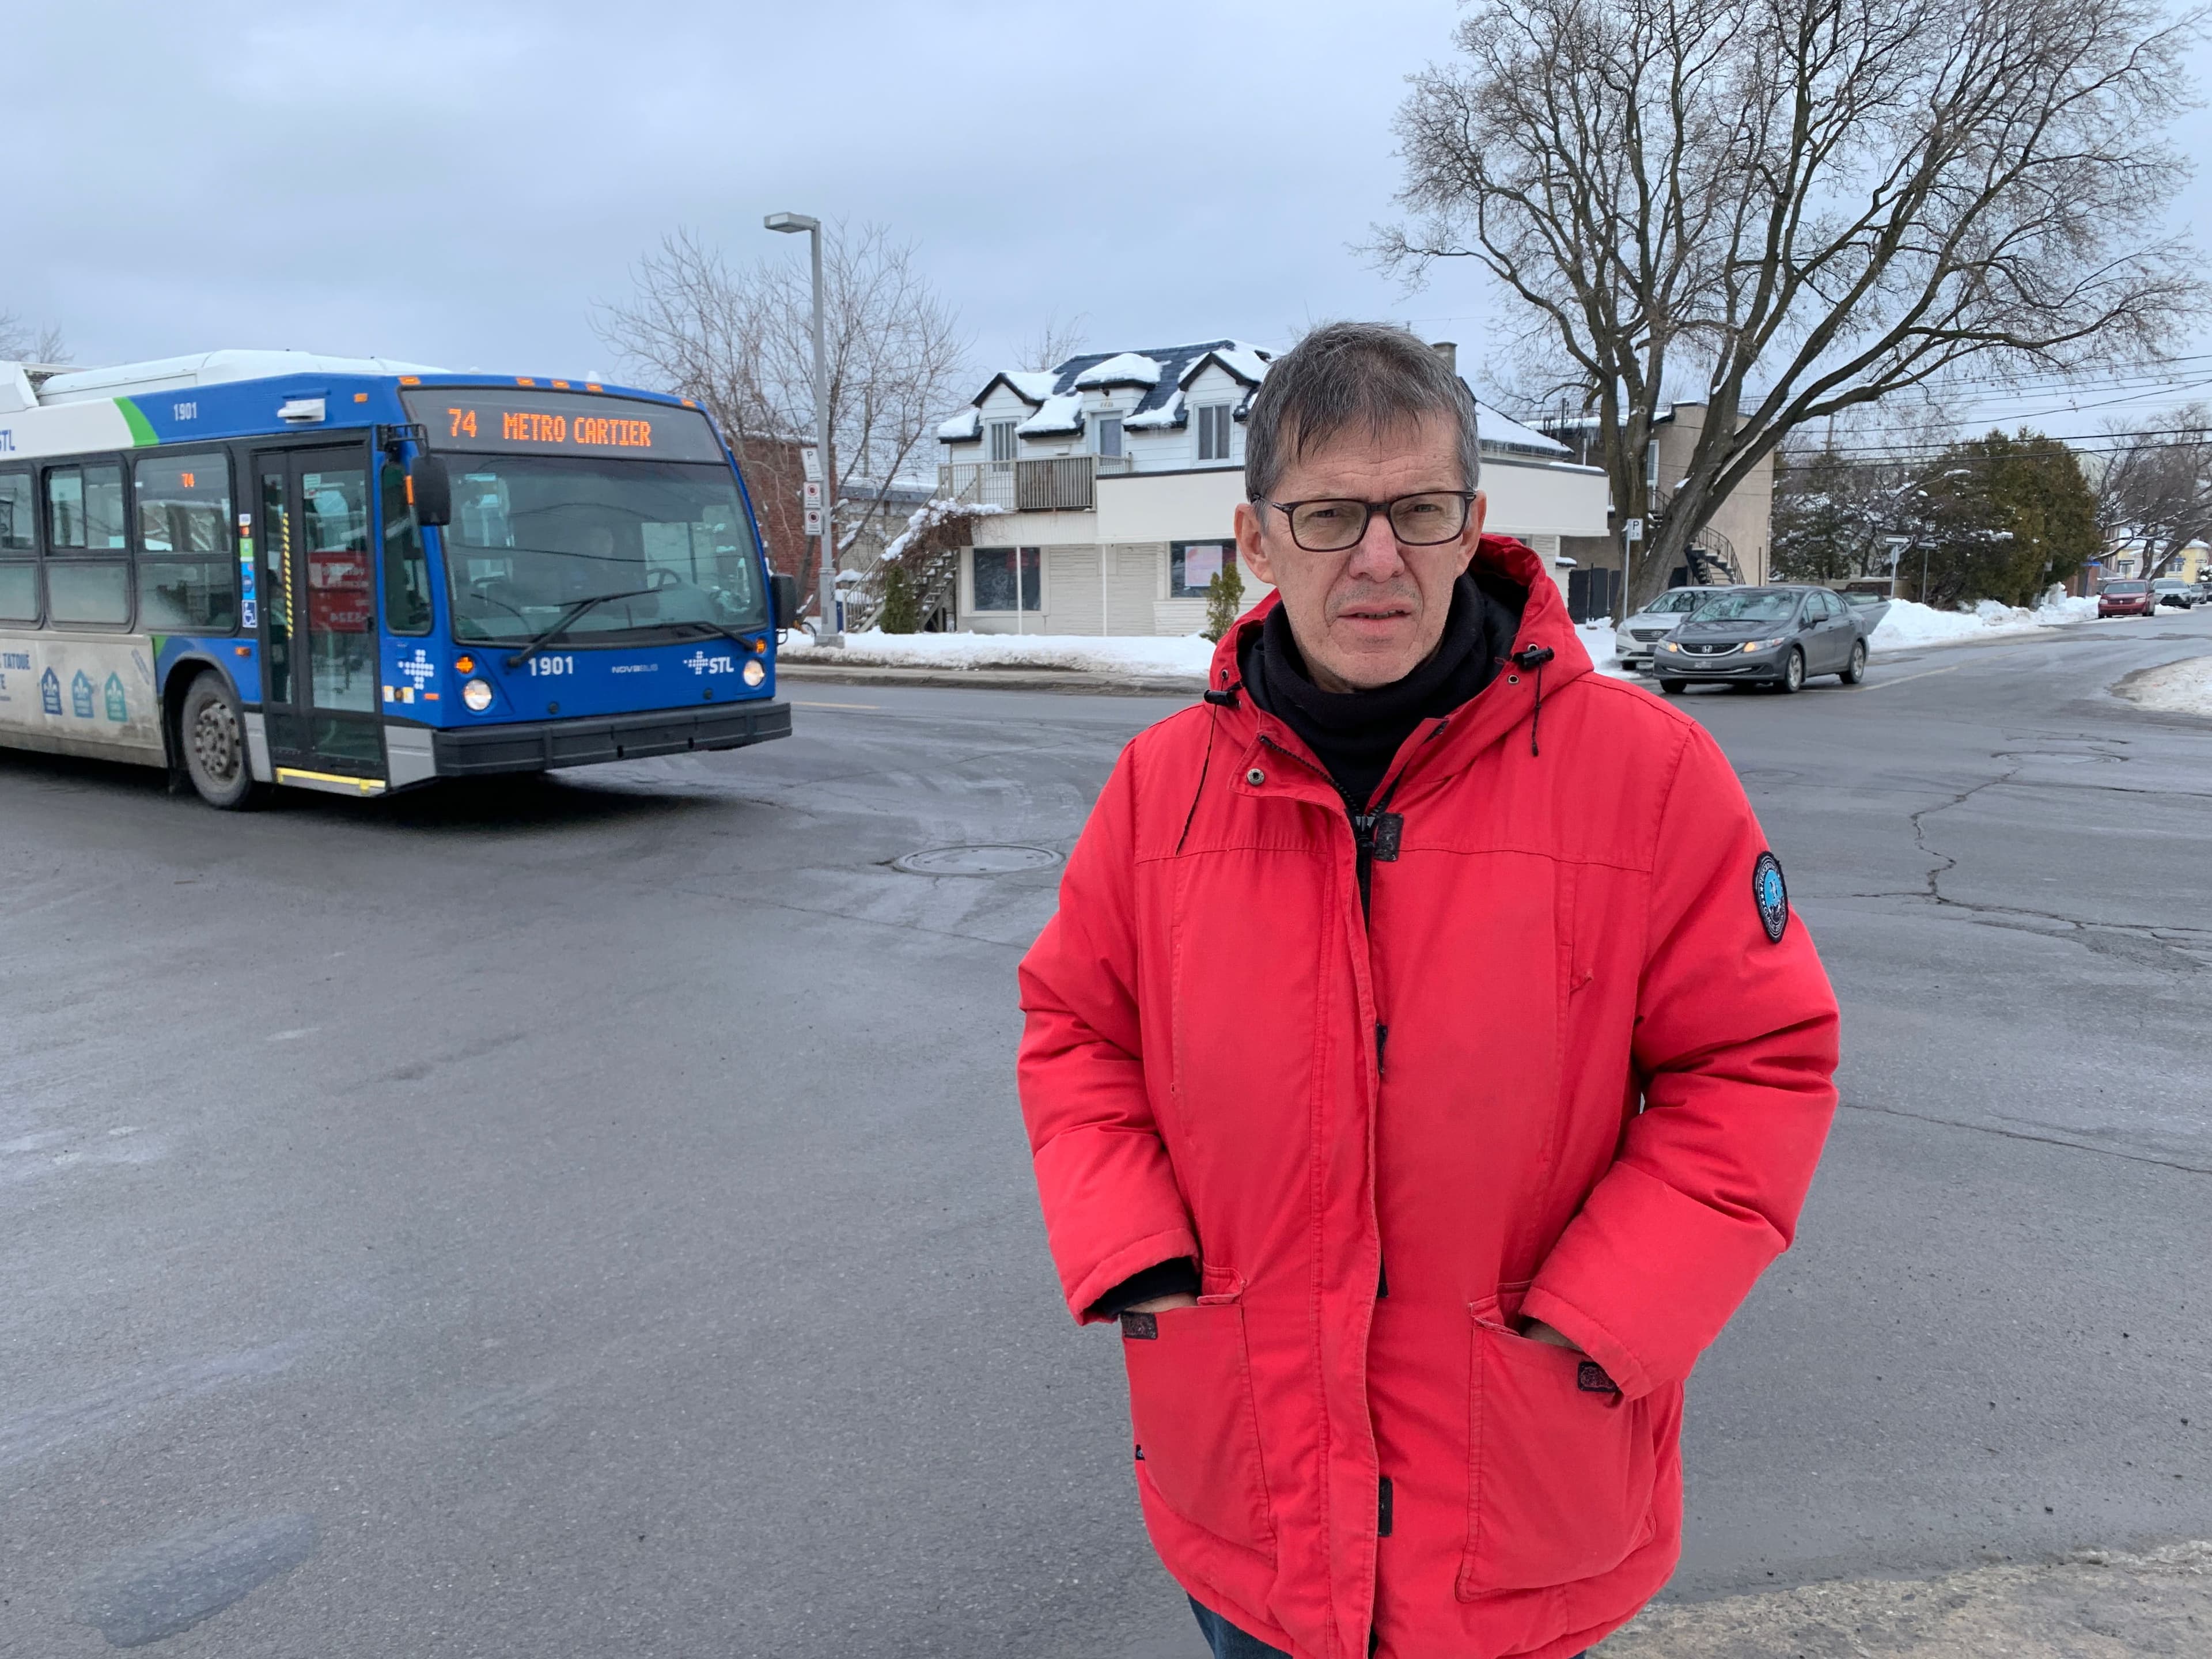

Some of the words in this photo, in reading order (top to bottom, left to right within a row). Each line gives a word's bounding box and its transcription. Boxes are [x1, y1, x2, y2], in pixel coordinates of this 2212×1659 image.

[173, 402, 198, 421] 1901
[448, 408, 477, 438] 74
[502, 412, 566, 443] METRO
[574, 416, 652, 447] CARTIER
[0, 429, 15, 452] TL
[806, 451, 813, 460] P
[181, 473, 195, 487] 74
[1633, 521, 1639, 530] P
[528, 656, 573, 676] 1901
[709, 657, 734, 675] STL
